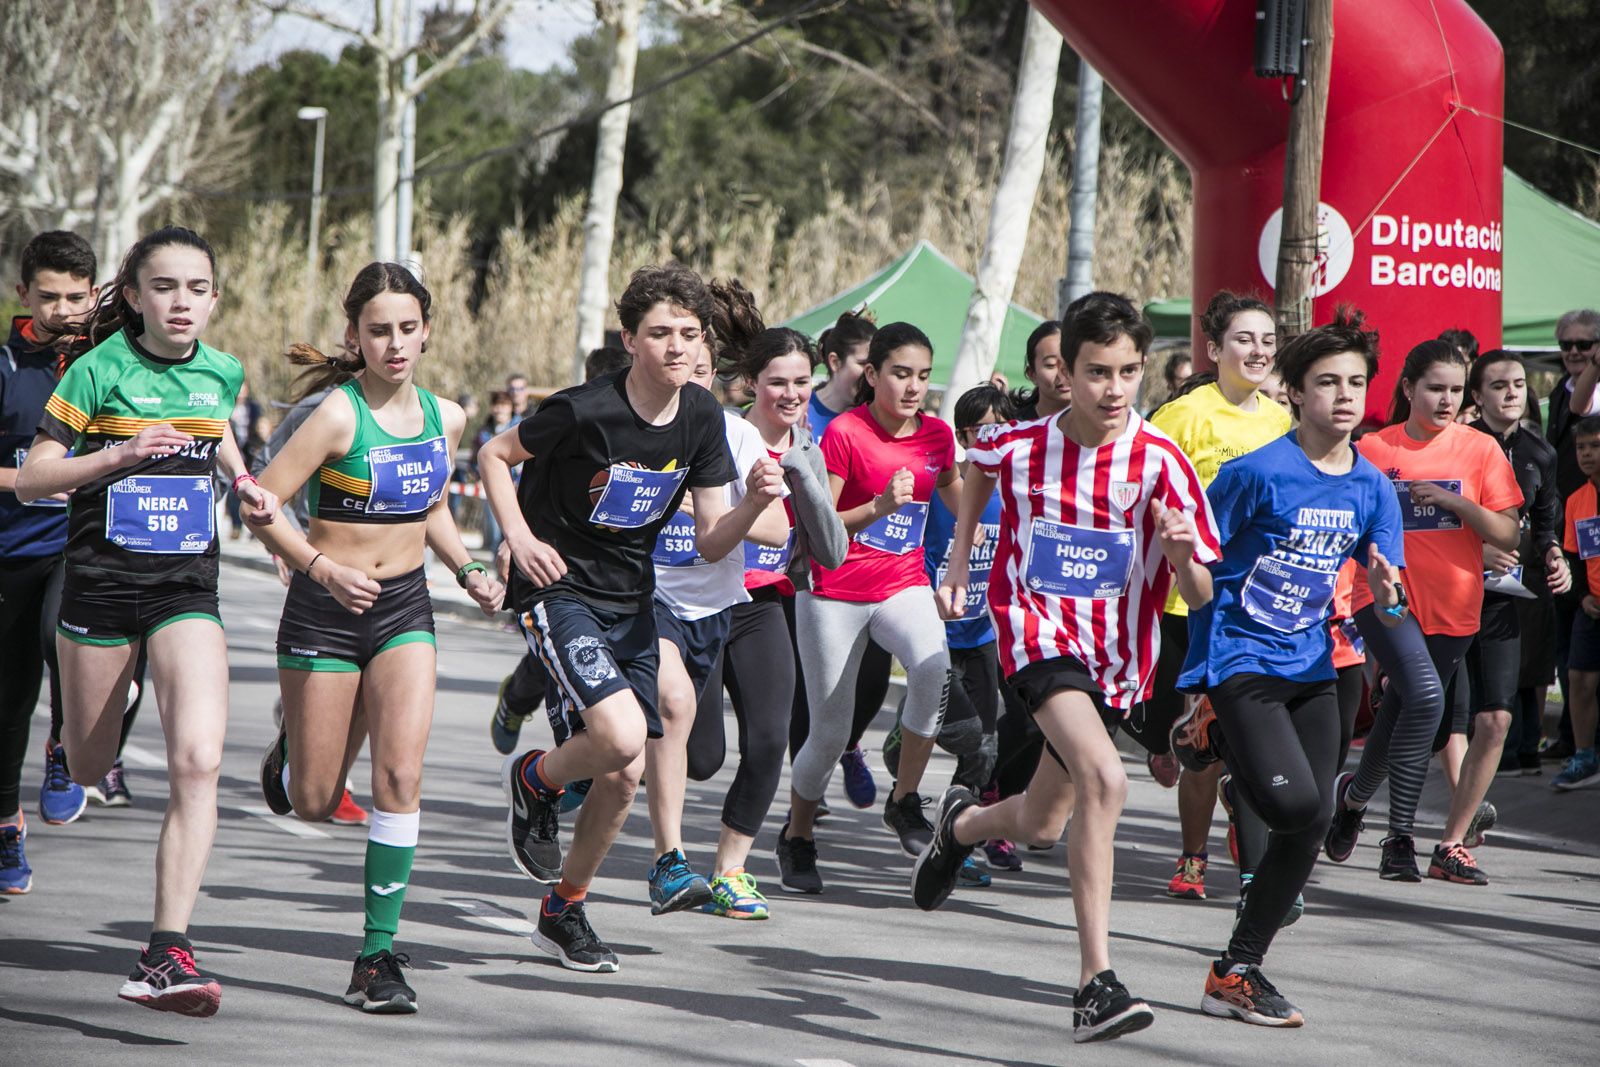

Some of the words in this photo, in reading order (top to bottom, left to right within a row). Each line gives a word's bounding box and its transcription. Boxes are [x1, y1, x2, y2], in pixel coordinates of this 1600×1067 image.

[1371, 214, 1501, 252] Diputació
[1371, 255, 1501, 291] Barcelona
[396, 460, 434, 477] NEILA
[402, 477, 430, 495] 525
[634, 486, 661, 497] PAU
[138, 497, 189, 511] NEREA
[630, 500, 652, 512] 511
[1413, 505, 1436, 517] 510
[147, 515, 178, 531] 518
[887, 513, 913, 526] CELIA
[1035, 521, 1058, 532] MILLES
[1297, 508, 1355, 529] INSTITUT
[884, 525, 908, 540] 533
[665, 539, 693, 552] 530
[1056, 544, 1108, 561] HUGO
[757, 552, 781, 565] 529
[1061, 561, 1098, 580] 509
[1281, 582, 1310, 598] PAU
[1272, 595, 1303, 615] 528
